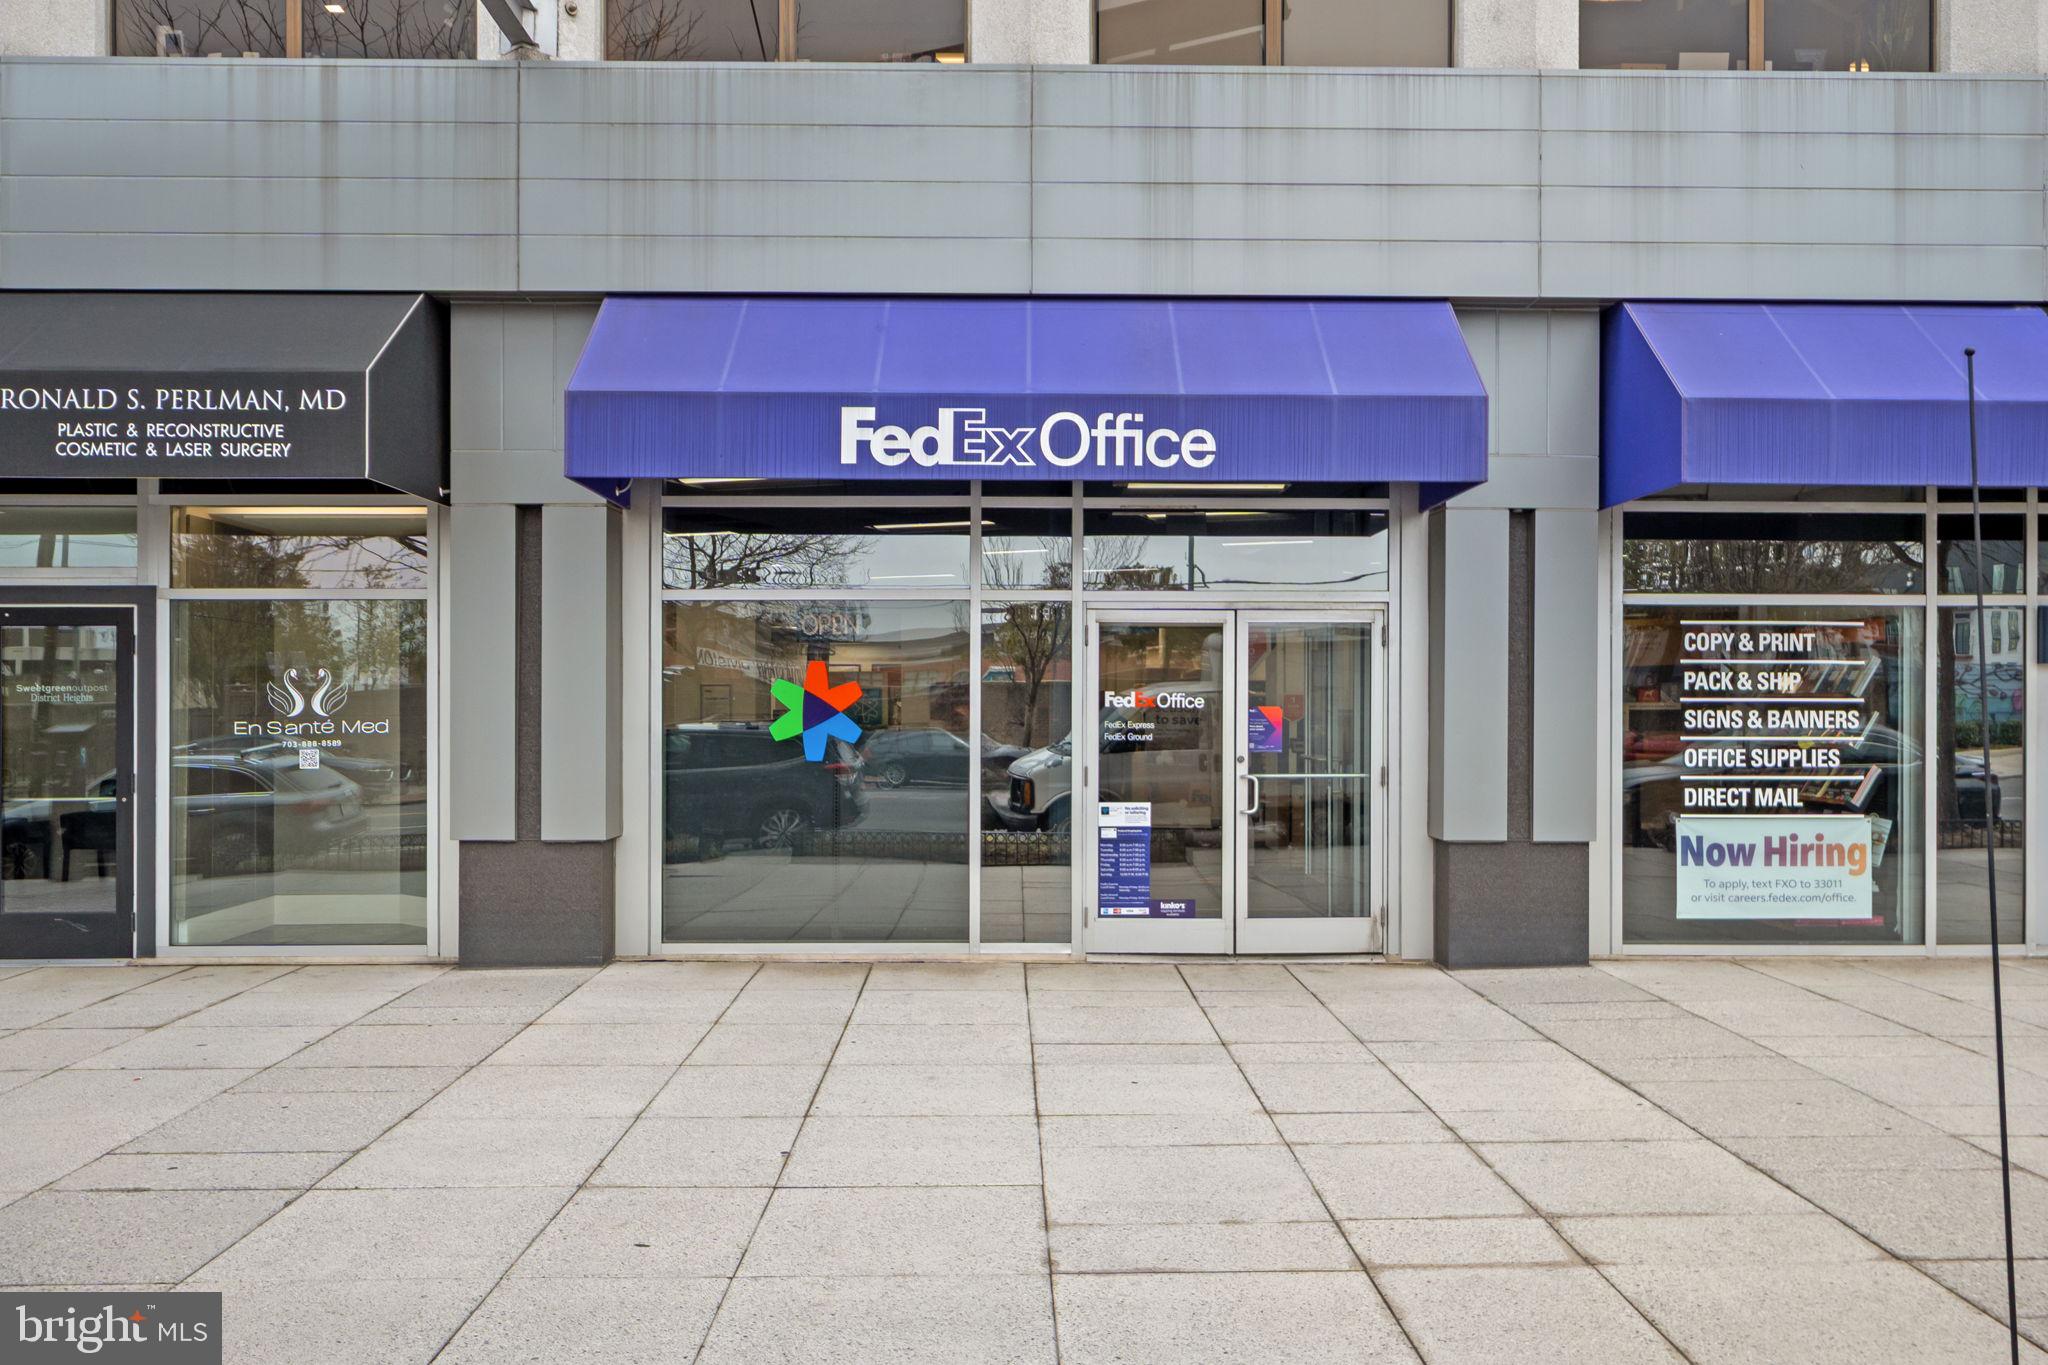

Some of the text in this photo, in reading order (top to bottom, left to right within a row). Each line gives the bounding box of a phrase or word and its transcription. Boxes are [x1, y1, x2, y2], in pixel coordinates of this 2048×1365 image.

[1, 388, 347, 413] RONALD S. PERLMAN, MD
[57, 422, 285, 438] PLASTIC & RECONSTRUCTIVE
[841, 406, 1217, 468] FedEx Office
[55, 442, 292, 457] COSMETIC & LASER SURGERY
[802, 613, 861, 636] OPEN
[1684, 632, 1816, 652] COPY & PRINT
[1683, 671, 1802, 691] PACK & SHIP
[31, 693, 94, 703] District Heights
[1104, 691, 1205, 709] FedEx Office
[234, 719, 389, 735] En Santé Med
[1104, 721, 1155, 730] FedEx Express
[1684, 710, 1860, 729] SIGNS & BANNERS
[1104, 733, 1126, 741] FedEx
[1127, 733, 1153, 741] Ground
[1684, 748, 1841, 768] OFFICE SUPPLIES
[1684, 788, 1803, 807] DIRECT MAIL
[1681, 833, 1867, 876] Now Hiring
[1704, 879, 1843, 891] To apply, text FXO to 33011
[1691, 895, 1702, 903] or
[1704, 892, 1725, 903] visit
